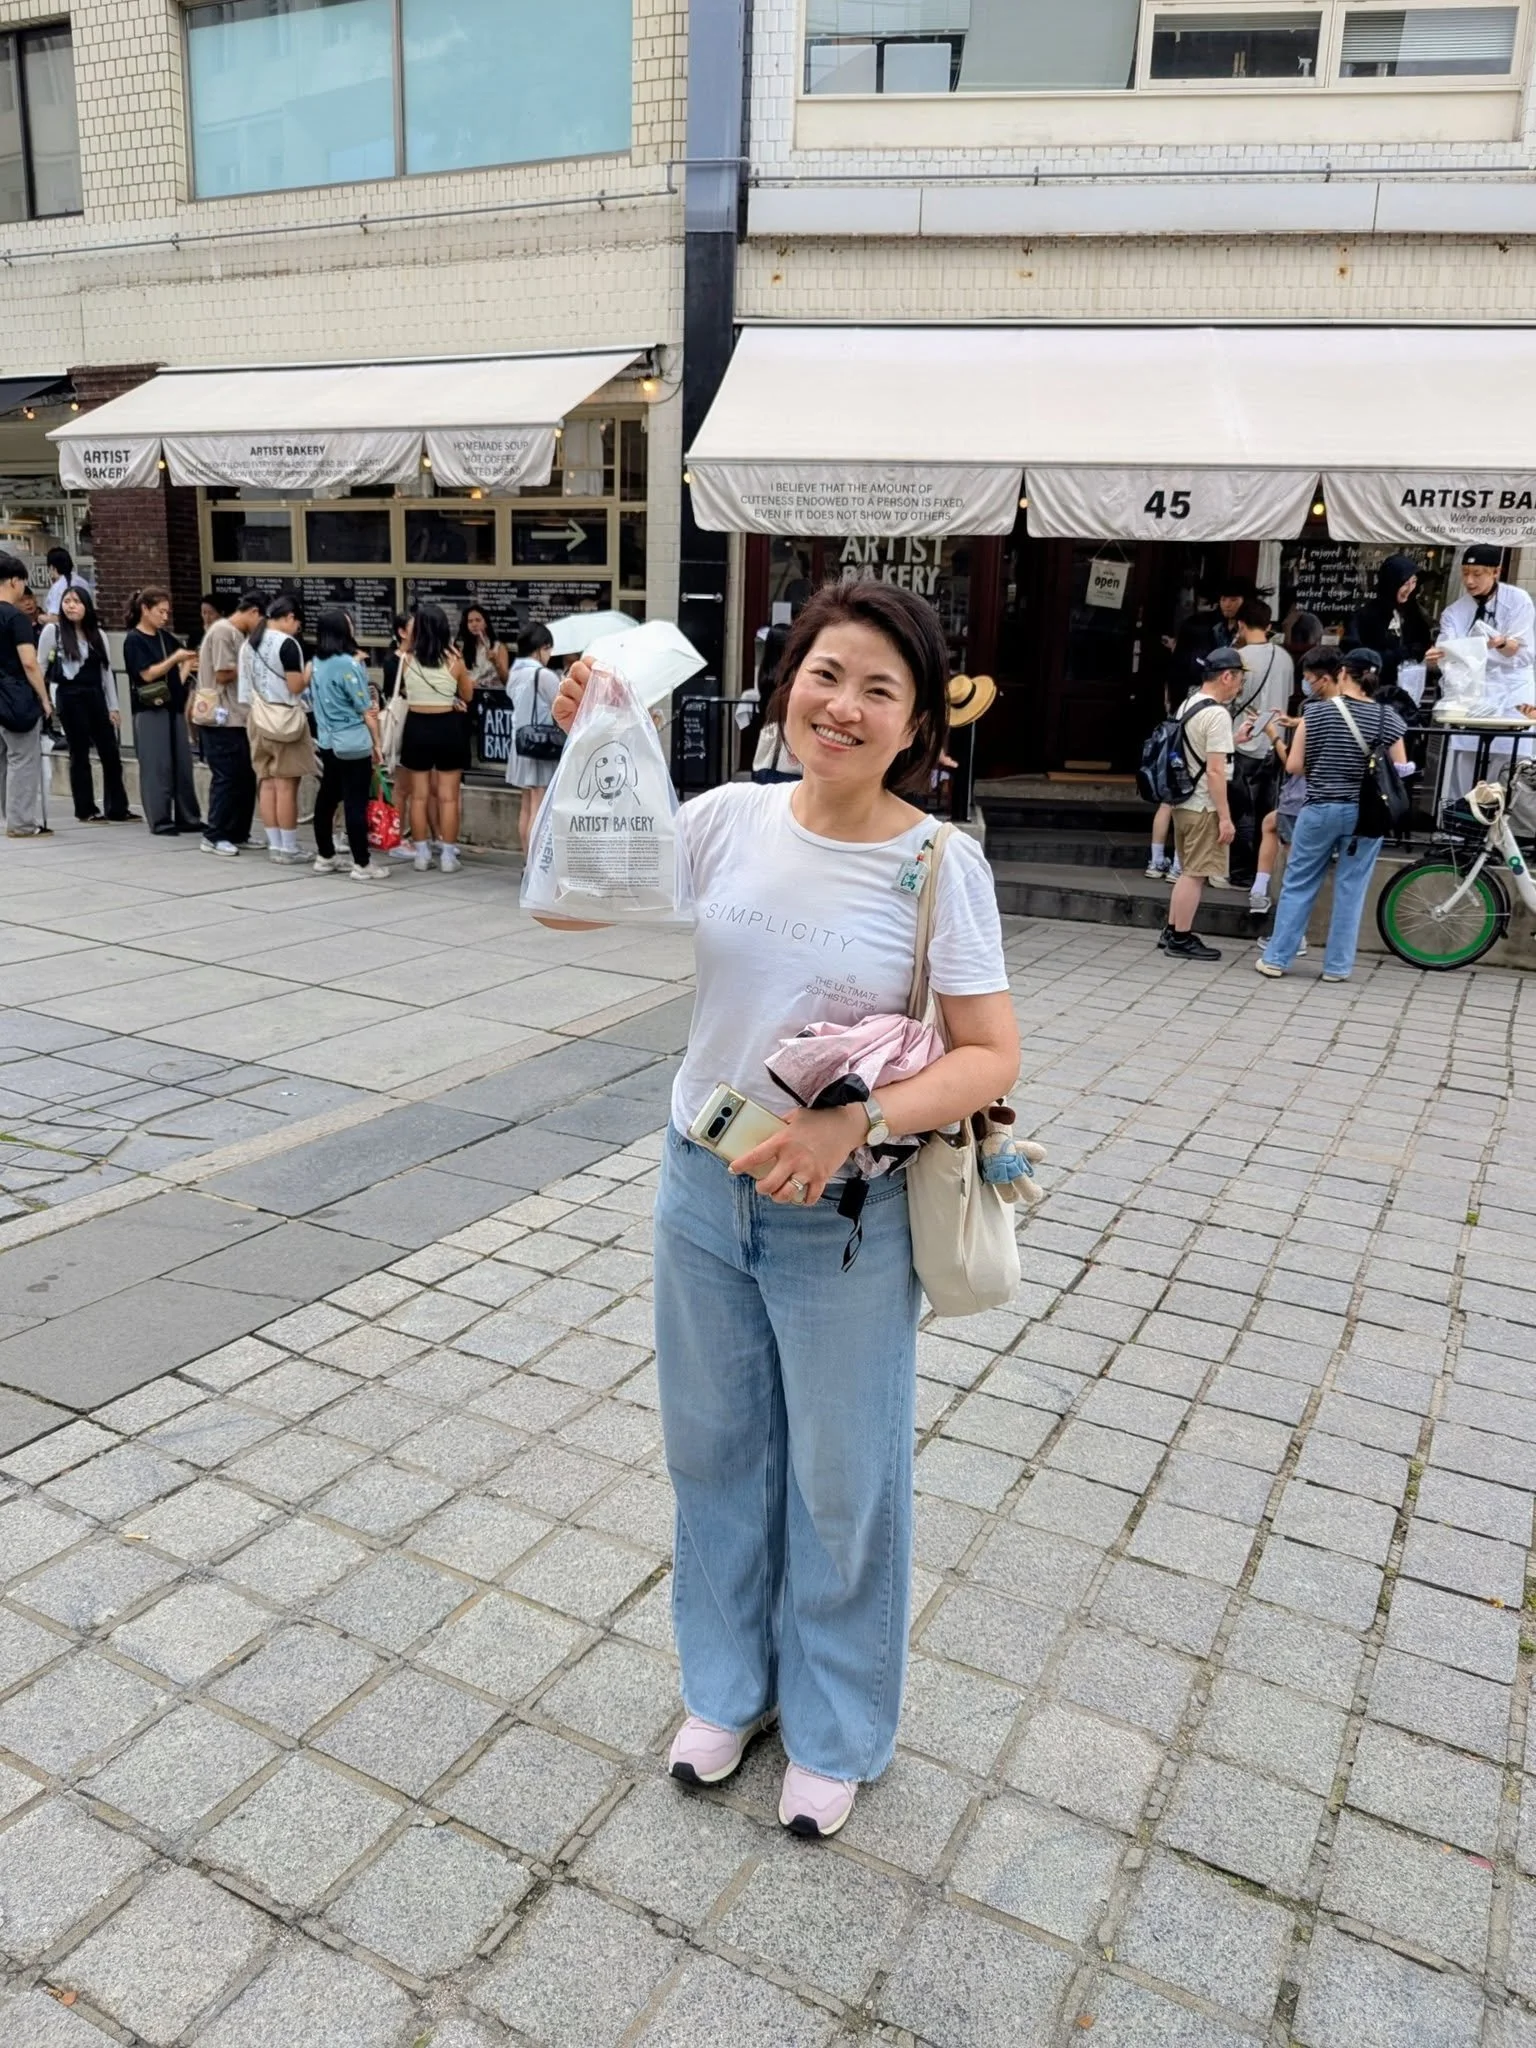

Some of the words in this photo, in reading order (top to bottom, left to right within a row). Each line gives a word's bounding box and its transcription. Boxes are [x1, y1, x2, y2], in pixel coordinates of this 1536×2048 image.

[250, 446, 284, 456] ARTIST
[286, 446, 326, 456] BAKERY
[453, 441, 502, 451] HOMEMADE
[504, 441, 529, 450] SOUP
[83, 450, 130, 463] ARTIST
[84, 467, 129, 479] BAKERY
[770, 483, 774, 491] I
[776, 483, 817, 493] BELIEVE
[820, 484, 845, 493] THAT
[848, 484, 868, 493] THE
[870, 483, 916, 494] AMOUNT
[918, 484, 933, 494] OF
[741, 496, 794, 506] CUTENESS
[796, 497, 849, 507] ENDOWED
[851, 497, 865, 506] TO
[867, 497, 876, 506] A
[877, 497, 919, 508] PERSON
[922, 498, 931, 507] IS
[1144, 490, 1191, 520] 45
[1400, 489, 1493, 508] ARTIST
[1499, 490, 1536, 509] BA
[754, 509, 781, 519] EVEN
[783, 510, 793, 519] IF
[795, 510, 805, 519] IT
[806, 510, 834, 520] DOES
[836, 511, 858, 520] NOT
[860, 510, 892, 520] SHOW
[894, 512, 908, 521] TO
[1450, 512, 1478, 523] We're
[1479, 513, 1515, 525] always
[1499, 527, 1518, 537] you
[840, 535, 947, 565] ARTIST
[1310, 546, 1341, 560] enjoyed
[840, 564, 941, 595] BAKERY
[1094, 576, 1120, 589] open
[569, 815, 610, 833] ARTIST
[705, 902, 855, 953] SIMPLICITY
[846, 973, 857, 984] IS
[815, 975, 833, 989] THE
[834, 982, 879, 1002] ULTIMATE
[805, 984, 878, 1012] SOPHISTICATION
